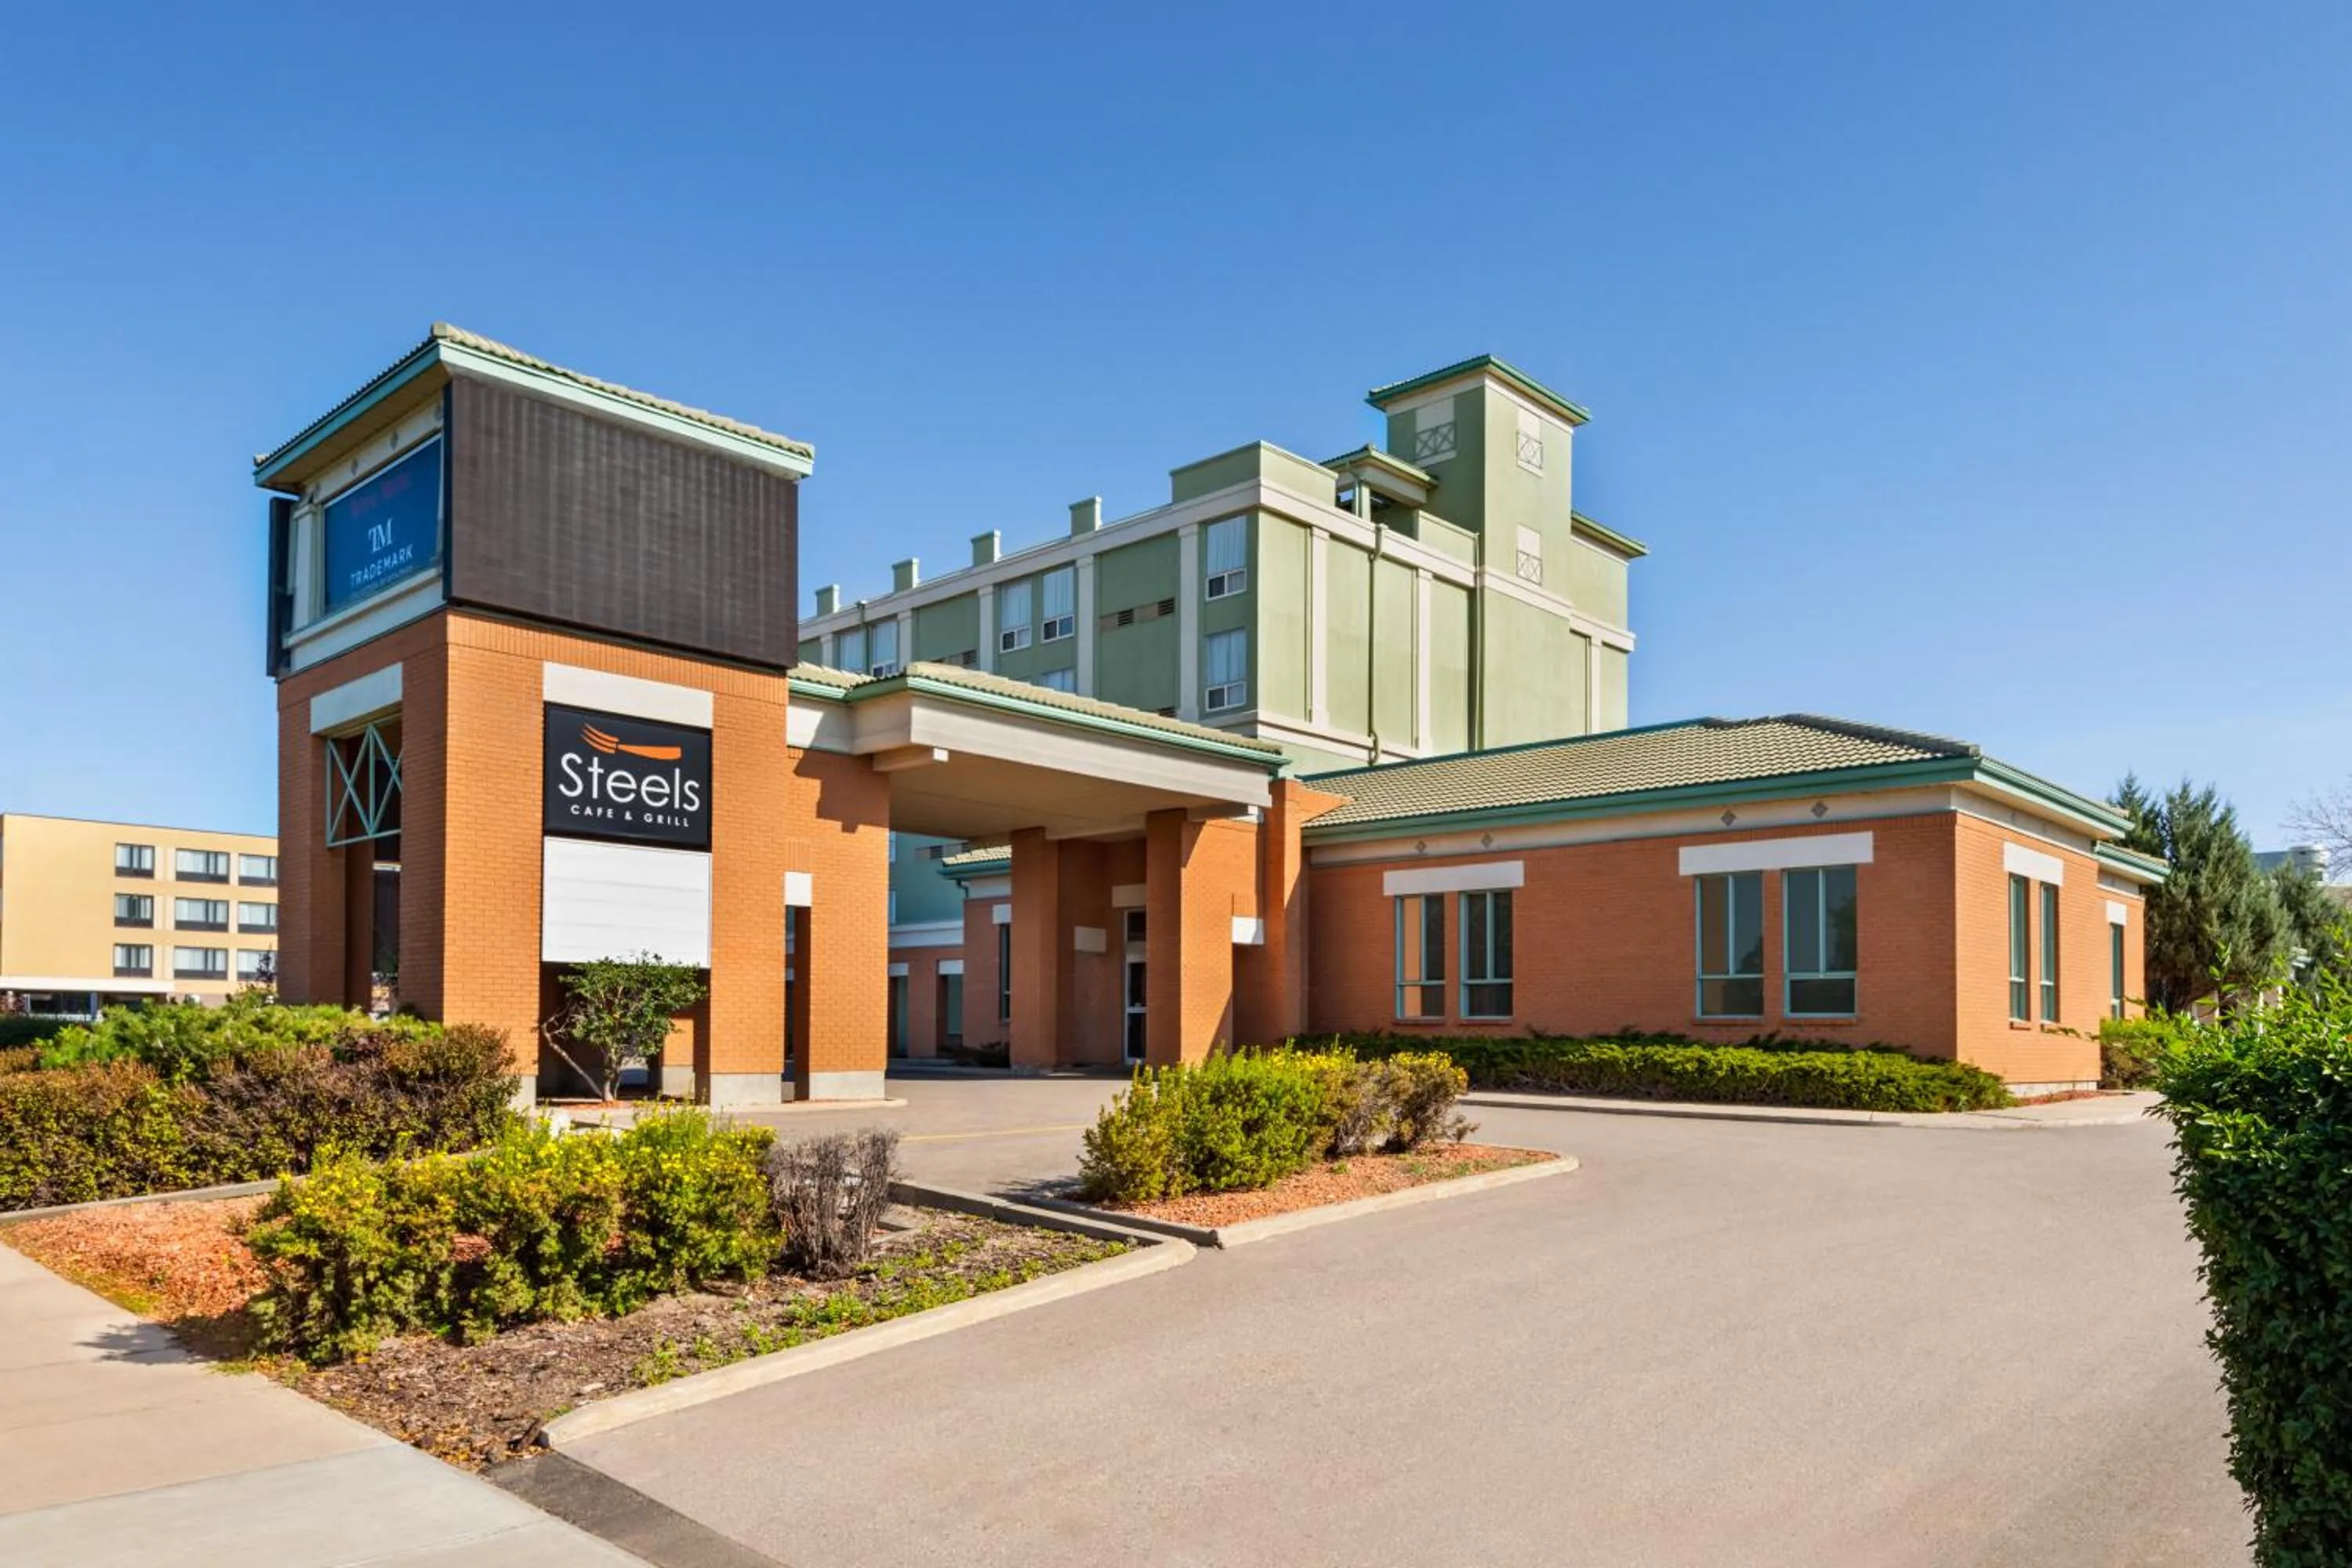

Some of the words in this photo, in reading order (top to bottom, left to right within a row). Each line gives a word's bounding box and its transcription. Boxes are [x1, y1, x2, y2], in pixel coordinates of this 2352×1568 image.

[350, 544, 414, 586] TRADEMARK
[558, 752, 700, 811] Steels
[570, 804, 614, 818] CAFE
[624, 811, 633, 821] &
[644, 813, 689, 827] GRILL
